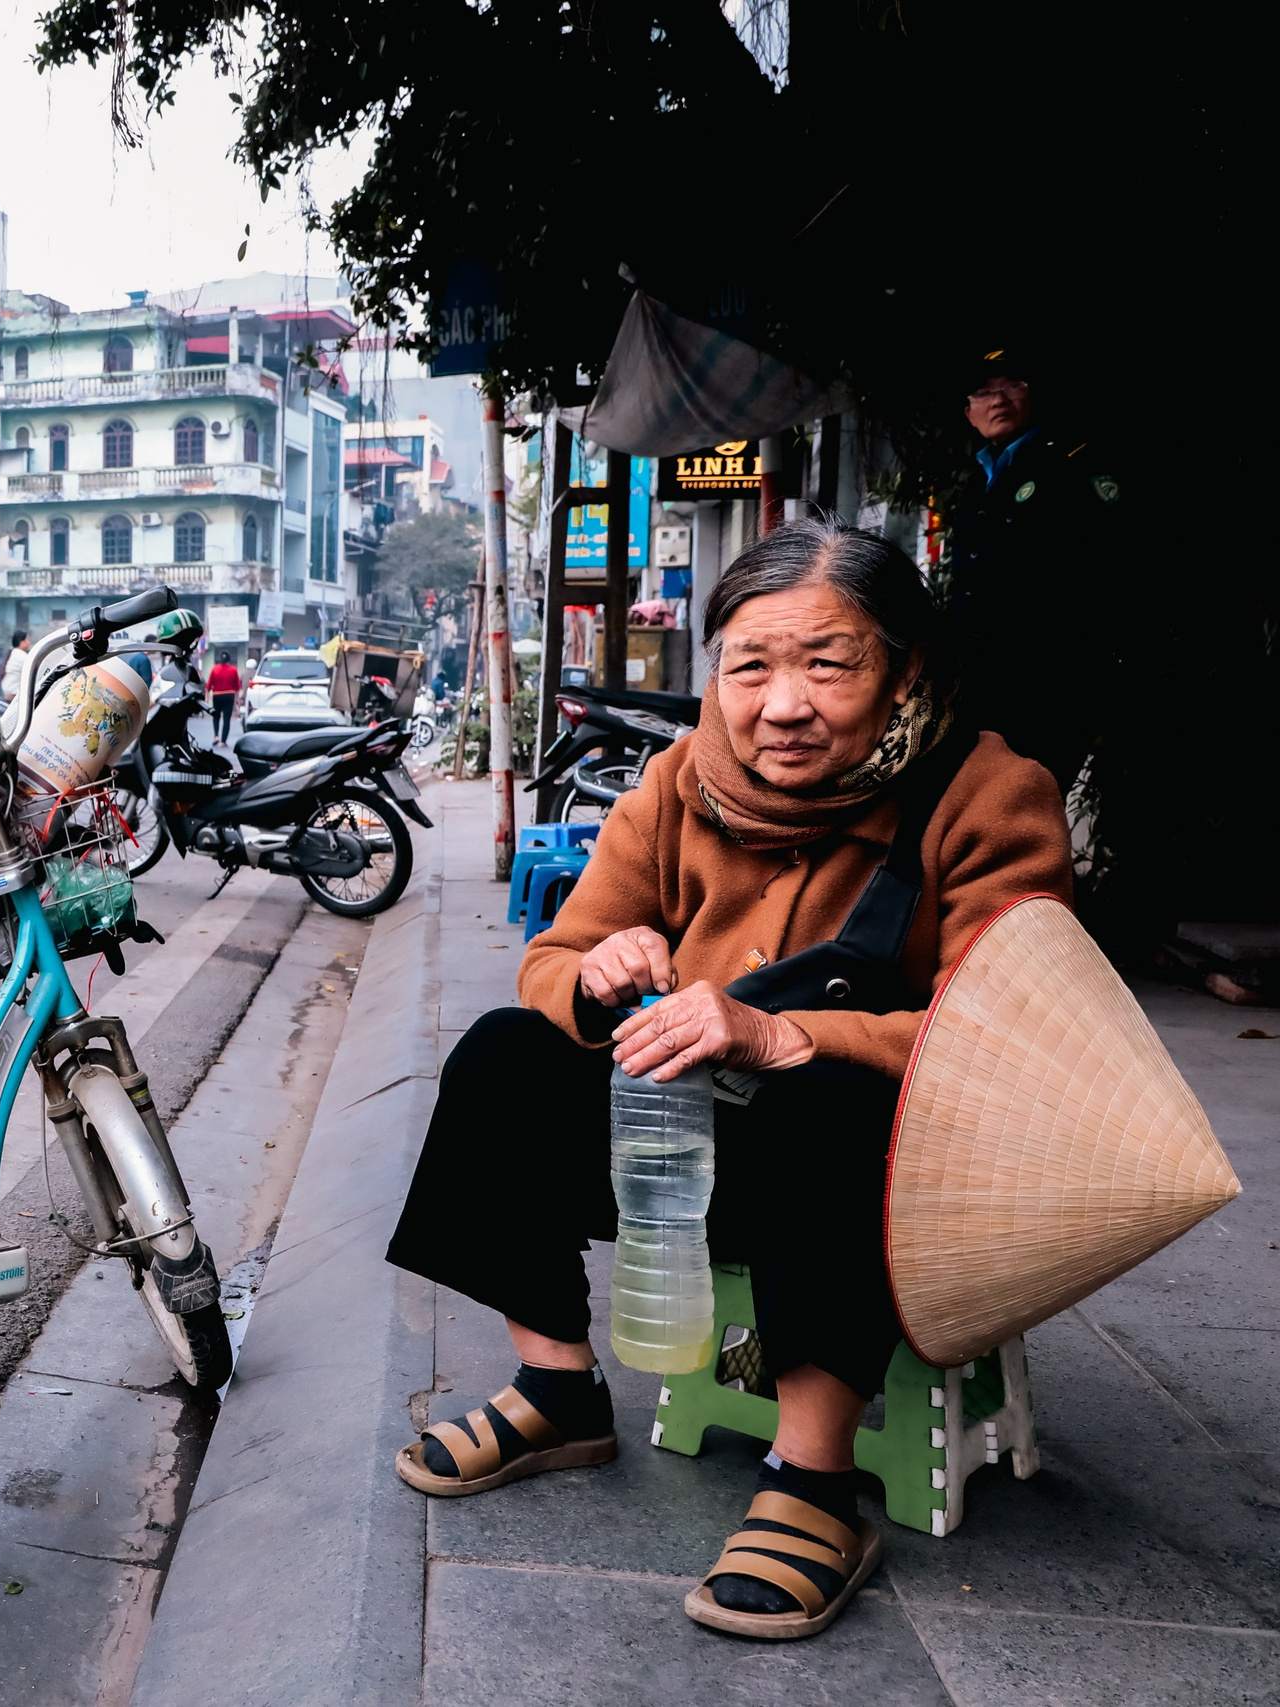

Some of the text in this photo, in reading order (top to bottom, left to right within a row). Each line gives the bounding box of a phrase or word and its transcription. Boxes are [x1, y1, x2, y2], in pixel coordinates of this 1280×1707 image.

[676, 457, 744, 475] LINH
[682, 480, 731, 489] EYEBROWS
[742, 480, 761, 488] BEA
